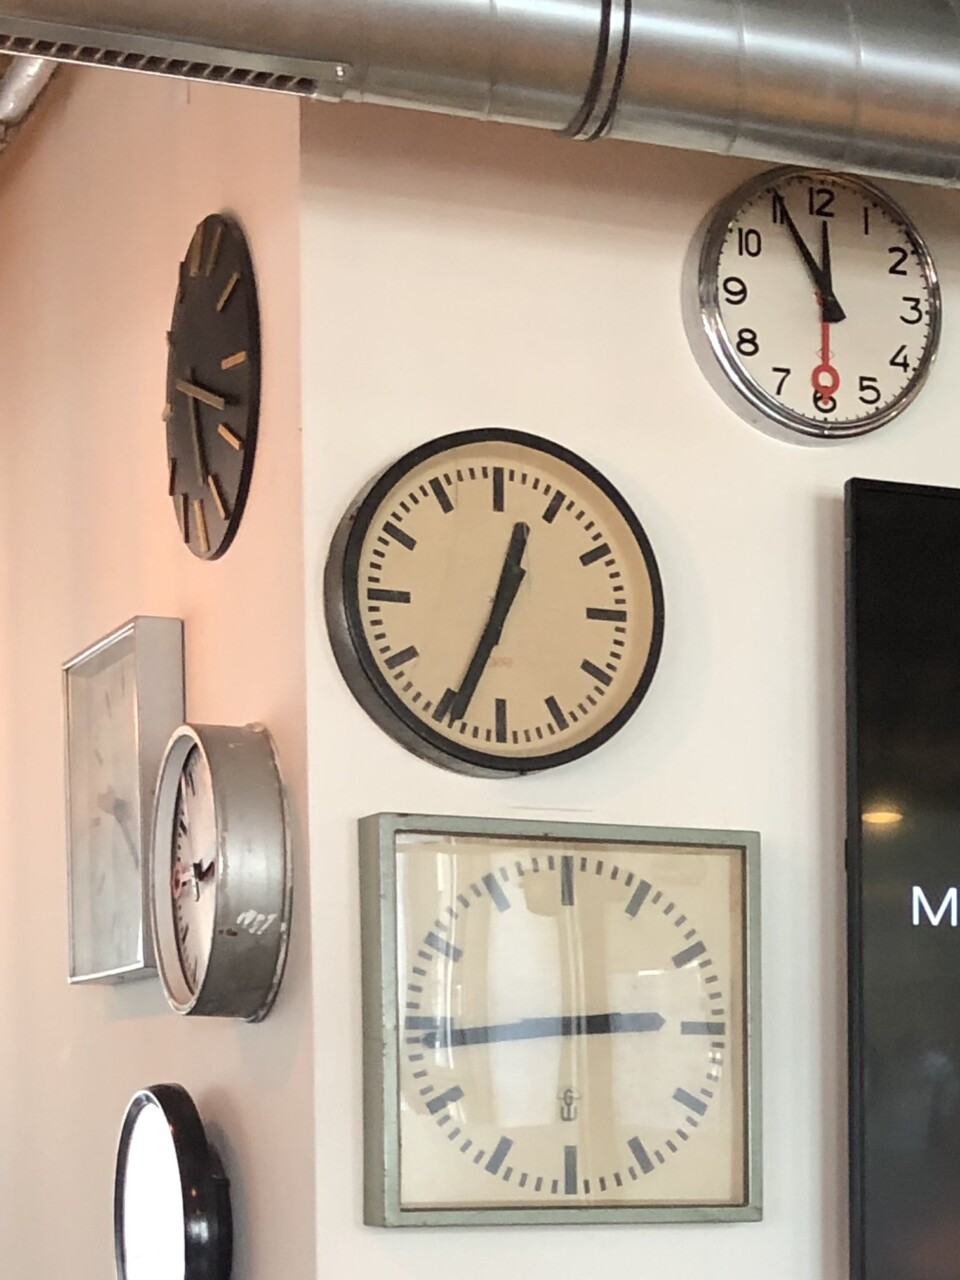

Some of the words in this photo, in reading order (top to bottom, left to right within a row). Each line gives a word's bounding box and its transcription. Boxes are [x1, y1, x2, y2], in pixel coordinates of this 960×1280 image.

[808, 187, 835, 217] 12
[863, 207, 869, 235] 1
[738, 227, 762, 257] 10
[888, 247, 908, 275] 2
[723, 276, 747, 305] 9
[900, 297, 923, 324] 3
[736, 328, 759, 356] 8
[889, 345, 910, 373] 4
[772, 367, 791, 395] 7
[858, 376, 882, 404] 5
